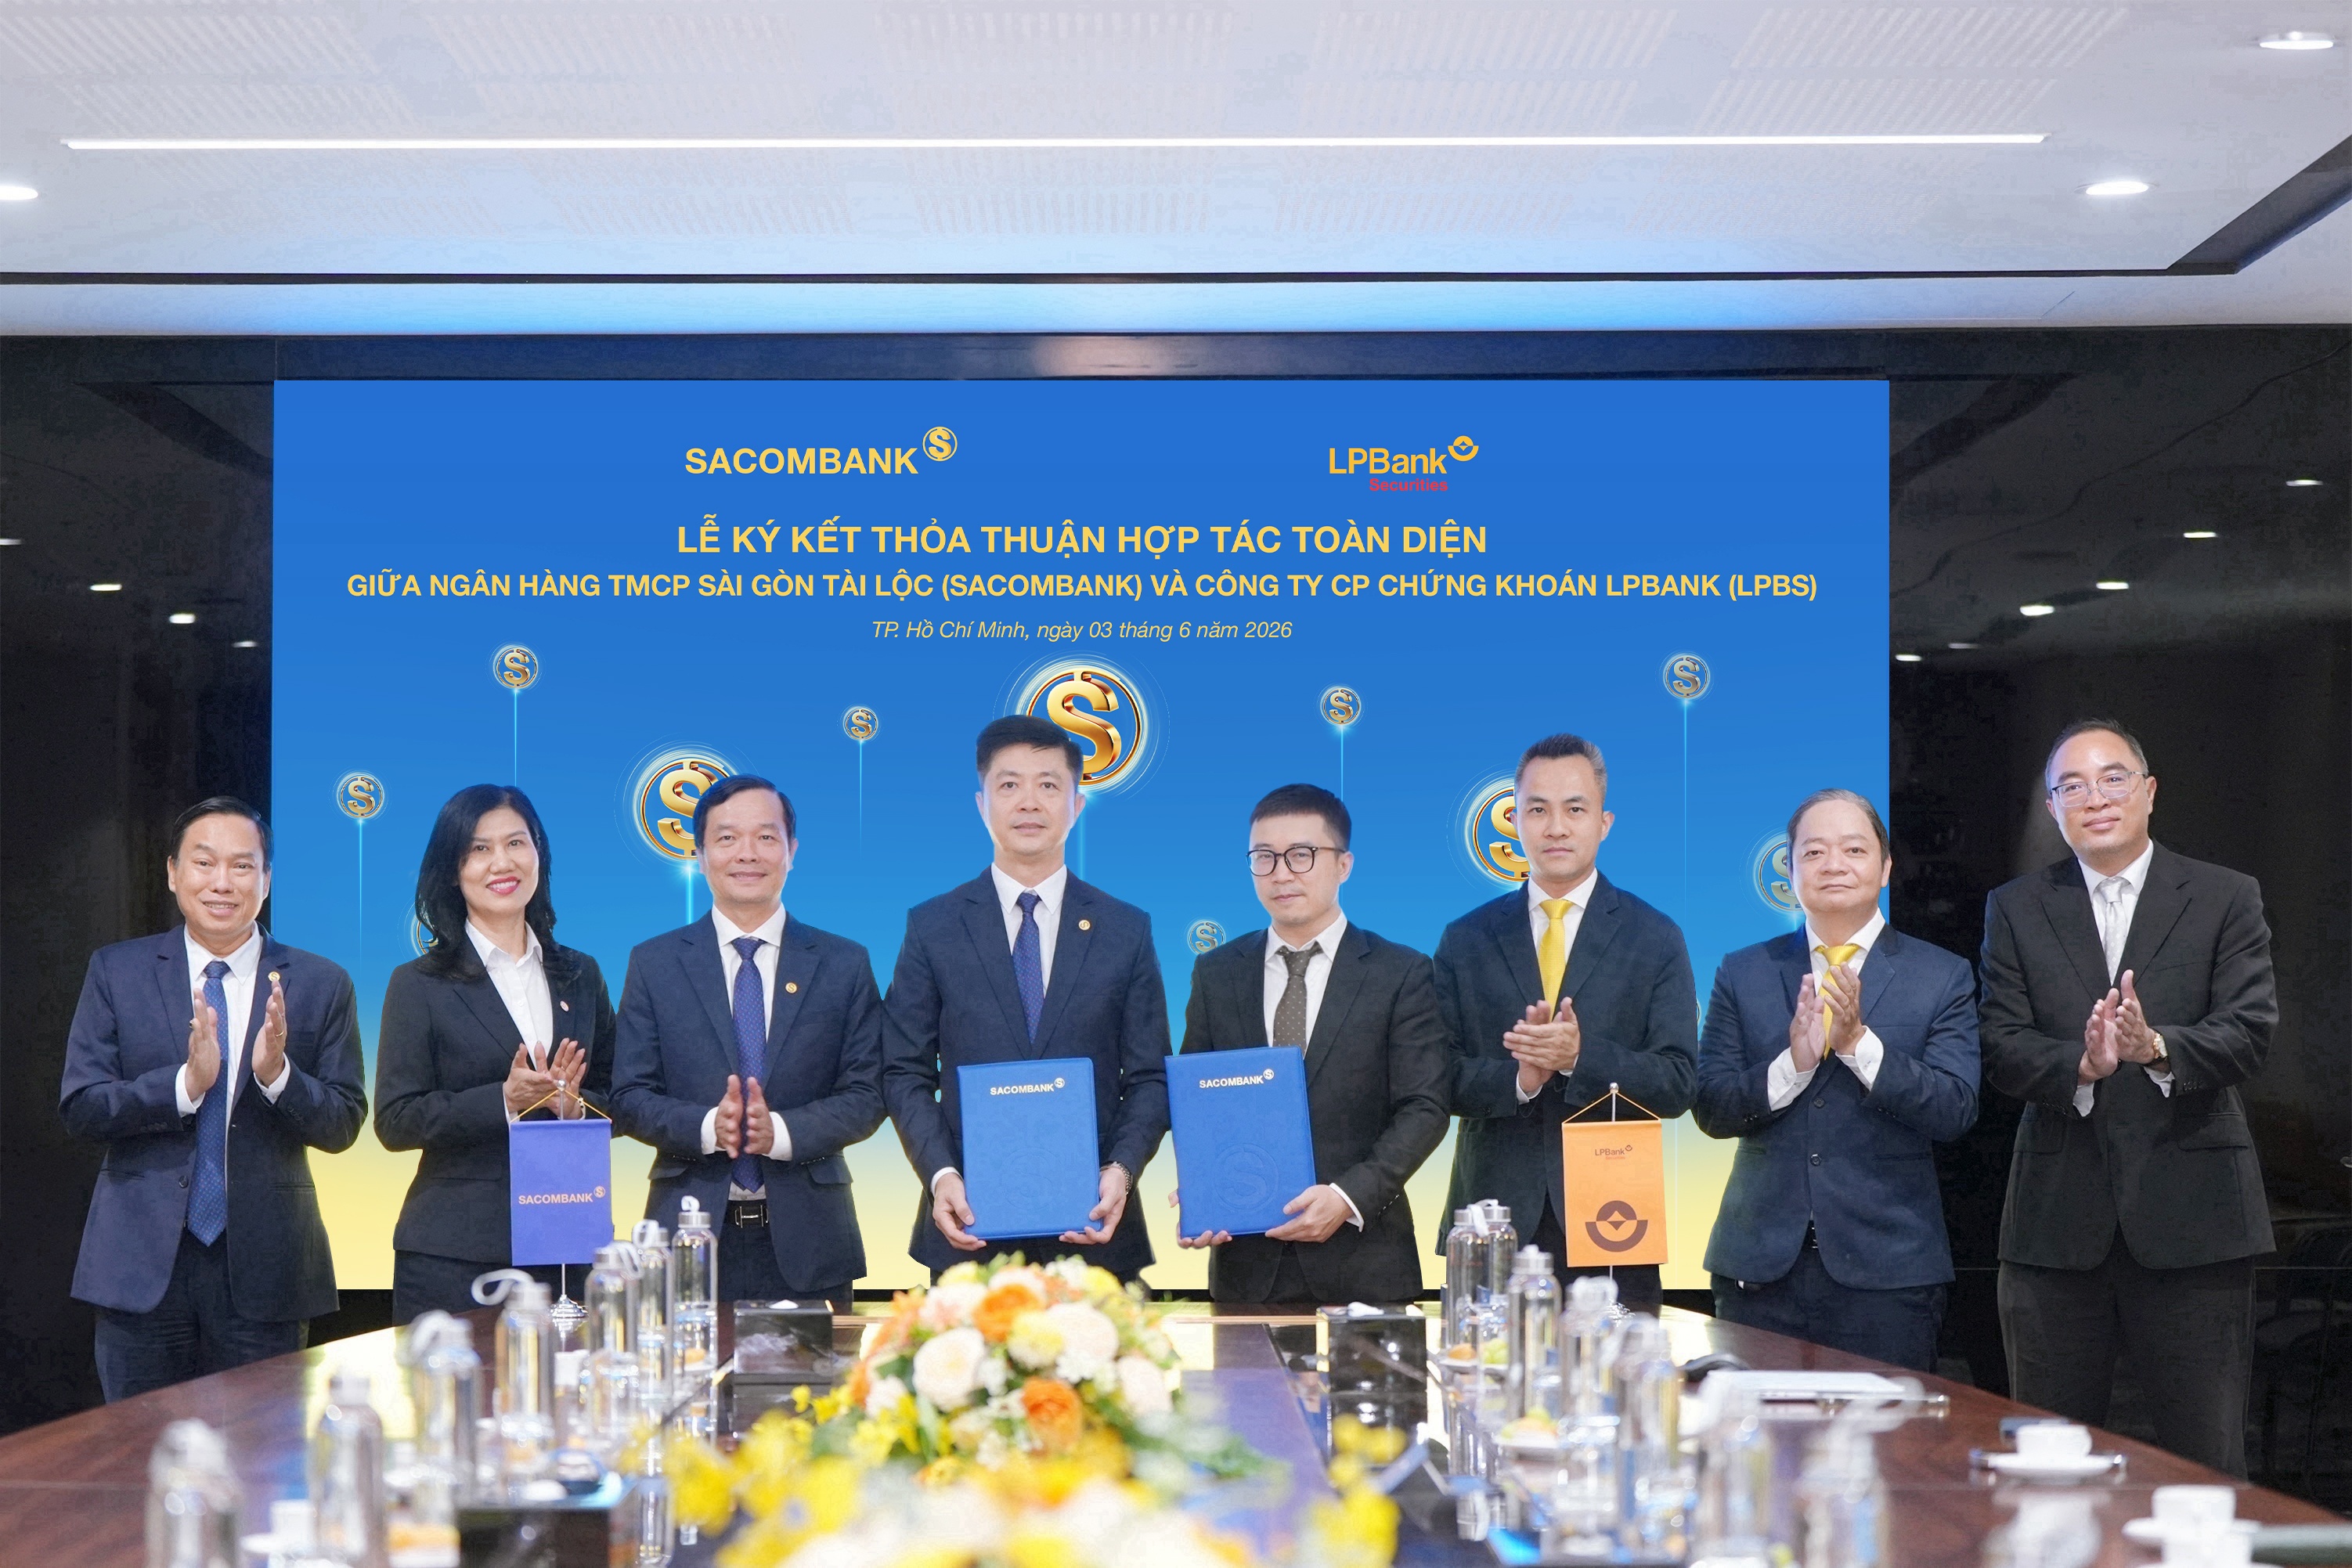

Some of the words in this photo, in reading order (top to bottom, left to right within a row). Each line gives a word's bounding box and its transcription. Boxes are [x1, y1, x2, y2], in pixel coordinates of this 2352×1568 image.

[685, 448, 918, 474] SACOMBANK
[1329, 448, 1448, 474] LPBank
[1369, 478, 1448, 492] Securities
[677, 514, 720, 553] LỄ
[734, 519, 781, 553] KÝ
[792, 516, 861, 553] KẾT
[871, 518, 971, 553] THỎA
[981, 519, 1104, 558] THUẬN
[1119, 526, 1199, 559] HỢP
[1210, 520, 1281, 553] TÁC
[1292, 520, 1389, 553] TOÀN
[1404, 519, 1485, 558] DIỆN
[348, 568, 421, 597] GIỮA
[431, 569, 510, 596] NGÂN
[520, 569, 600, 596] HÀNG
[608, 575, 690, 596] TMCP
[698, 569, 741, 596] SÀI
[752, 569, 813, 596] GÒN
[823, 569, 865, 596] TÀI
[876, 568, 933, 601] LỘC
[943, 575, 1142, 601] (SACOMBANK)
[1150, 569, 1188, 596] VÀ
[1196, 569, 1279, 596] CÔNG
[1287, 575, 1323, 596] TY
[1332, 575, 1369, 596] CP
[1379, 569, 1486, 597] CHỨNG
[1496, 569, 1596, 596] KHOÁN
[1607, 575, 1721, 596] LPBANK
[1730, 575, 1816, 601] (LPBS)
[872, 622, 899, 638] TP.
[907, 619, 933, 638] Hồ
[940, 621, 974, 638] Chí
[978, 621, 1029, 640] Minh,
[1037, 621, 1084, 643] ngày
[1090, 622, 1112, 638] 03
[1120, 621, 1173, 643] tháng
[1180, 622, 1191, 638] 6
[1196, 621, 1238, 638] năm
[1245, 622, 1293, 638] 2026
[990, 1083, 1055, 1095] SACOMBANK
[1198, 1075, 1264, 1088] SACOMBANK
[1594, 1148, 1625, 1156] LPBank
[518, 1193, 593, 1204] SACOMBANK
